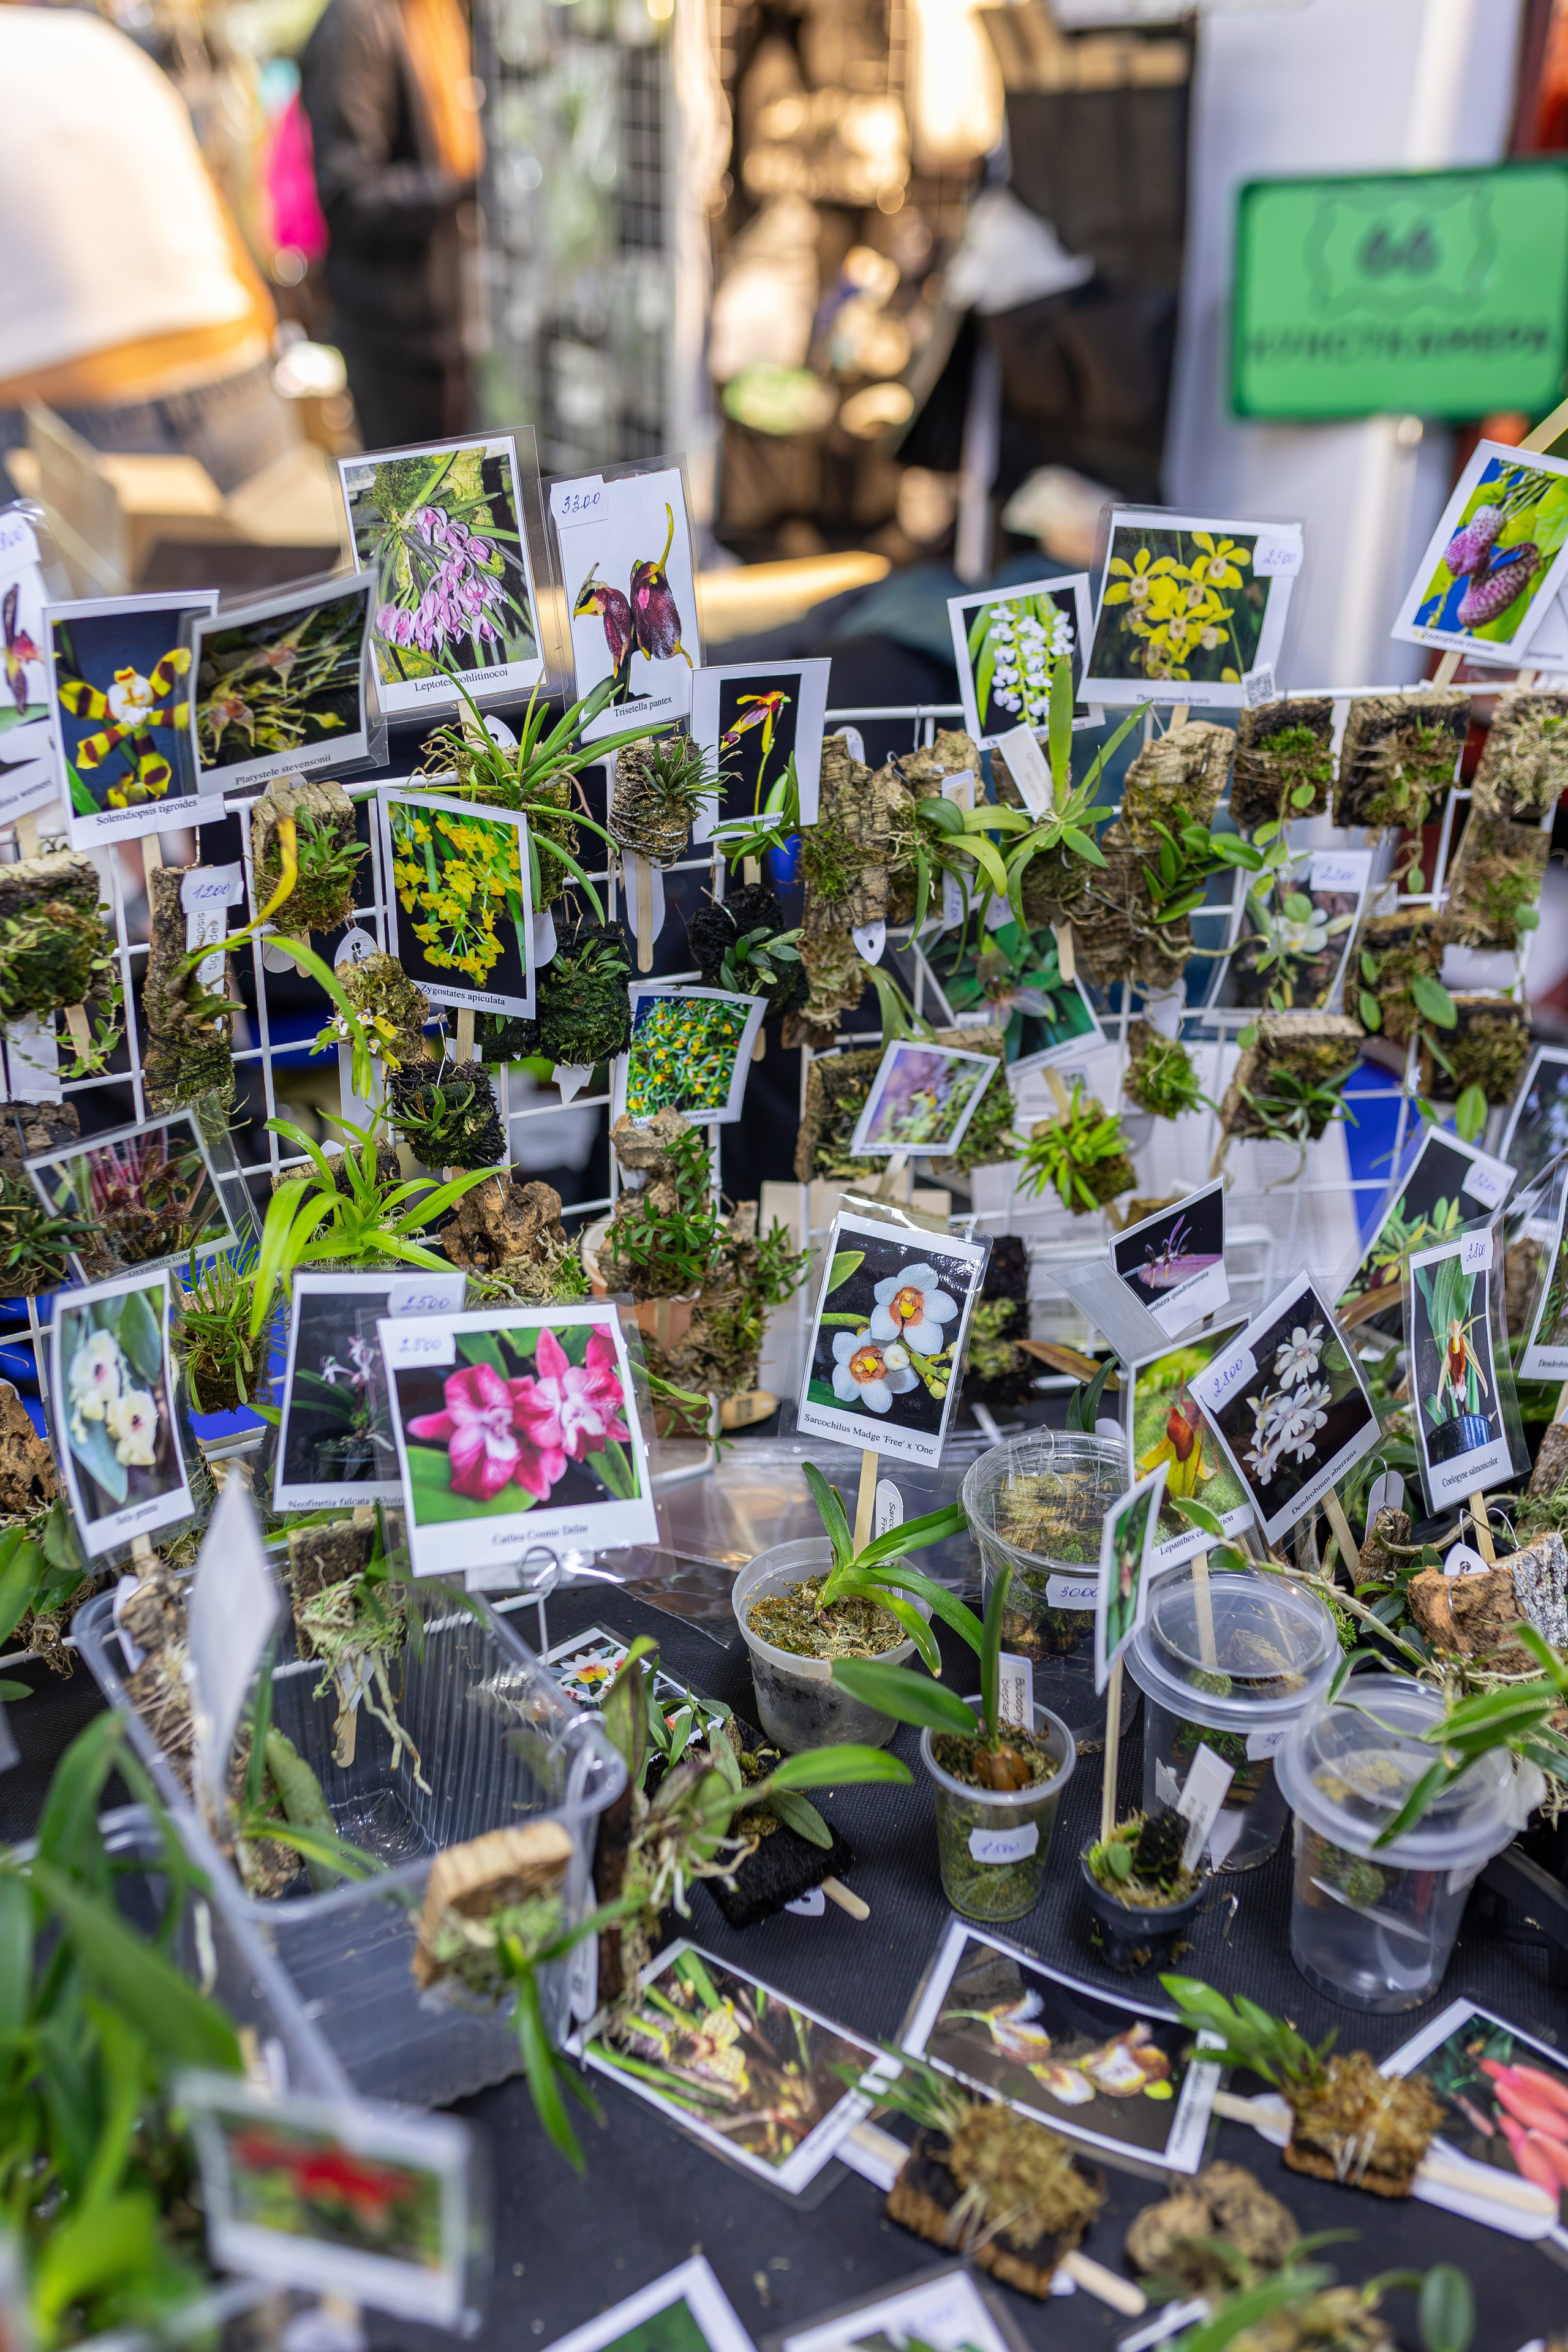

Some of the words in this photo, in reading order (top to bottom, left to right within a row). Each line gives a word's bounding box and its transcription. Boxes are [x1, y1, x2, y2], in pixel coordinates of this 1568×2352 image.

[562, 492, 600, 514] 3300
[414, 678, 453, 693] Leptotes
[614, 702, 647, 717] Trisetella
[649, 696, 673, 710] pantex
[235, 769, 279, 785] Platystele
[281, 753, 331, 772] stevensonii
[96, 807, 157, 826] Solenidiopsis
[159, 799, 197, 815] tigroides
[192, 883, 231, 899] 1200
[421, 984, 466, 1000] Zygostates
[467, 993, 505, 1006] apiculata
[129, 1259, 170, 1277] Dryadella
[173, 1249, 198, 1262] hirtzi
[399, 1295, 450, 1311] 2500
[397, 1338, 442, 1352] 2500
[804, 1414, 850, 1433] Sarcochilus
[853, 1427, 880, 1441] Madge
[883, 1435, 905, 1447] 'Free'
[914, 1443, 936, 1455] 'One'
[1291, 1476, 1330, 1516] Dendrobium
[1330, 1449, 1357, 1477] aberrans
[1442, 1470, 1468, 1488] Coelogyne
[1468, 1457, 1498, 1477] salmonicolor
[1159, 1533, 1195, 1556] Lepanthes
